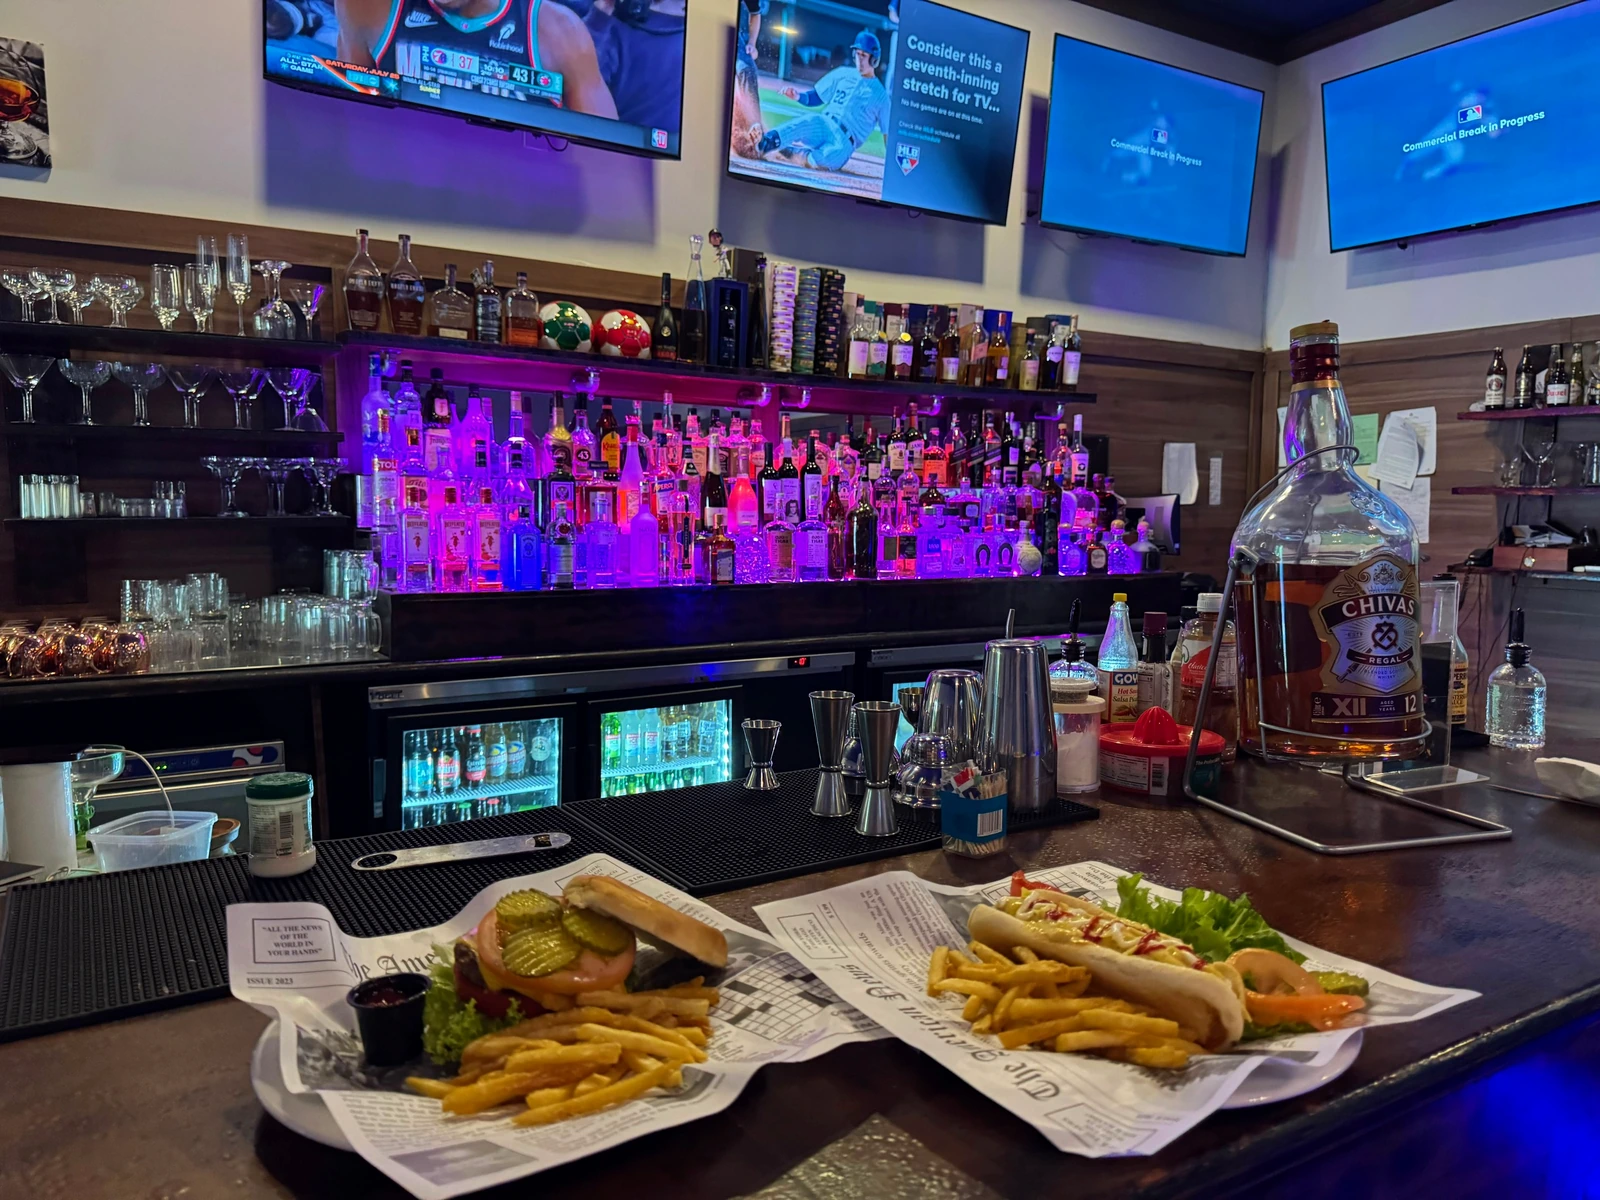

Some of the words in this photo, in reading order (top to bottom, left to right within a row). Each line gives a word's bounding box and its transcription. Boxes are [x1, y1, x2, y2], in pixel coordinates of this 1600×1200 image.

[409, 10, 432, 23] NIKE
[422, 46, 430, 62] PHI
[489, 38, 524, 54] Robinhood
[907, 34, 966, 63] Consider
[968, 52, 992, 71] this
[994, 62, 1002, 73] a
[289, 64, 314, 75] GAME
[325, 59, 369, 74] SATURDAY,
[370, 69, 389, 77] JULY
[458, 55, 473, 70] 37
[483, 63, 505, 74] 10:10
[512, 66, 528, 83] 43
[904, 57, 1000, 95] seventh-inning
[903, 77, 949, 99] stretch
[952, 87, 971, 105] for
[973, 93, 1000, 113] TV...
[901, 98, 909, 107] No
[910, 100, 919, 109] live
[920, 103, 938, 114] games
[938, 107, 947, 115] are
[955, 111, 961, 119] at
[961, 112, 971, 122] this
[898, 120, 914, 130] Check
[1402, 131, 1457, 153] Commercial
[1458, 124, 1487, 139] Break
[1488, 122, 1498, 133] in
[1500, 110, 1546, 129] Progress
[898, 145, 919, 158] MLB
[1110, 137, 1150, 155] Commercial
[1150, 147, 1168, 159] Break
[1169, 151, 1175, 161] in
[1175, 153, 1202, 167] Progress
[578, 450, 589, 460] 43
[1341, 595, 1415, 617] CHIVAS
[1368, 656, 1402, 664] REGAL
[1114, 673, 1138, 685] GOY
[1112, 695, 1128, 703] Salsa
[1332, 697, 1367, 716] XII
[1404, 694, 1417, 714] 12
[283, 925, 300, 933] THE
[300, 924, 323, 932] NEWS
[808, 919, 830, 946] FRANCISCO
[267, 949, 290, 957] YOUR
[273, 941, 303, 949] WORLD
[858, 931, 885, 960] towards
[246, 977, 274, 985] ISSUE
[275, 977, 294, 985] 2023
[840, 963, 909, 1002] News
